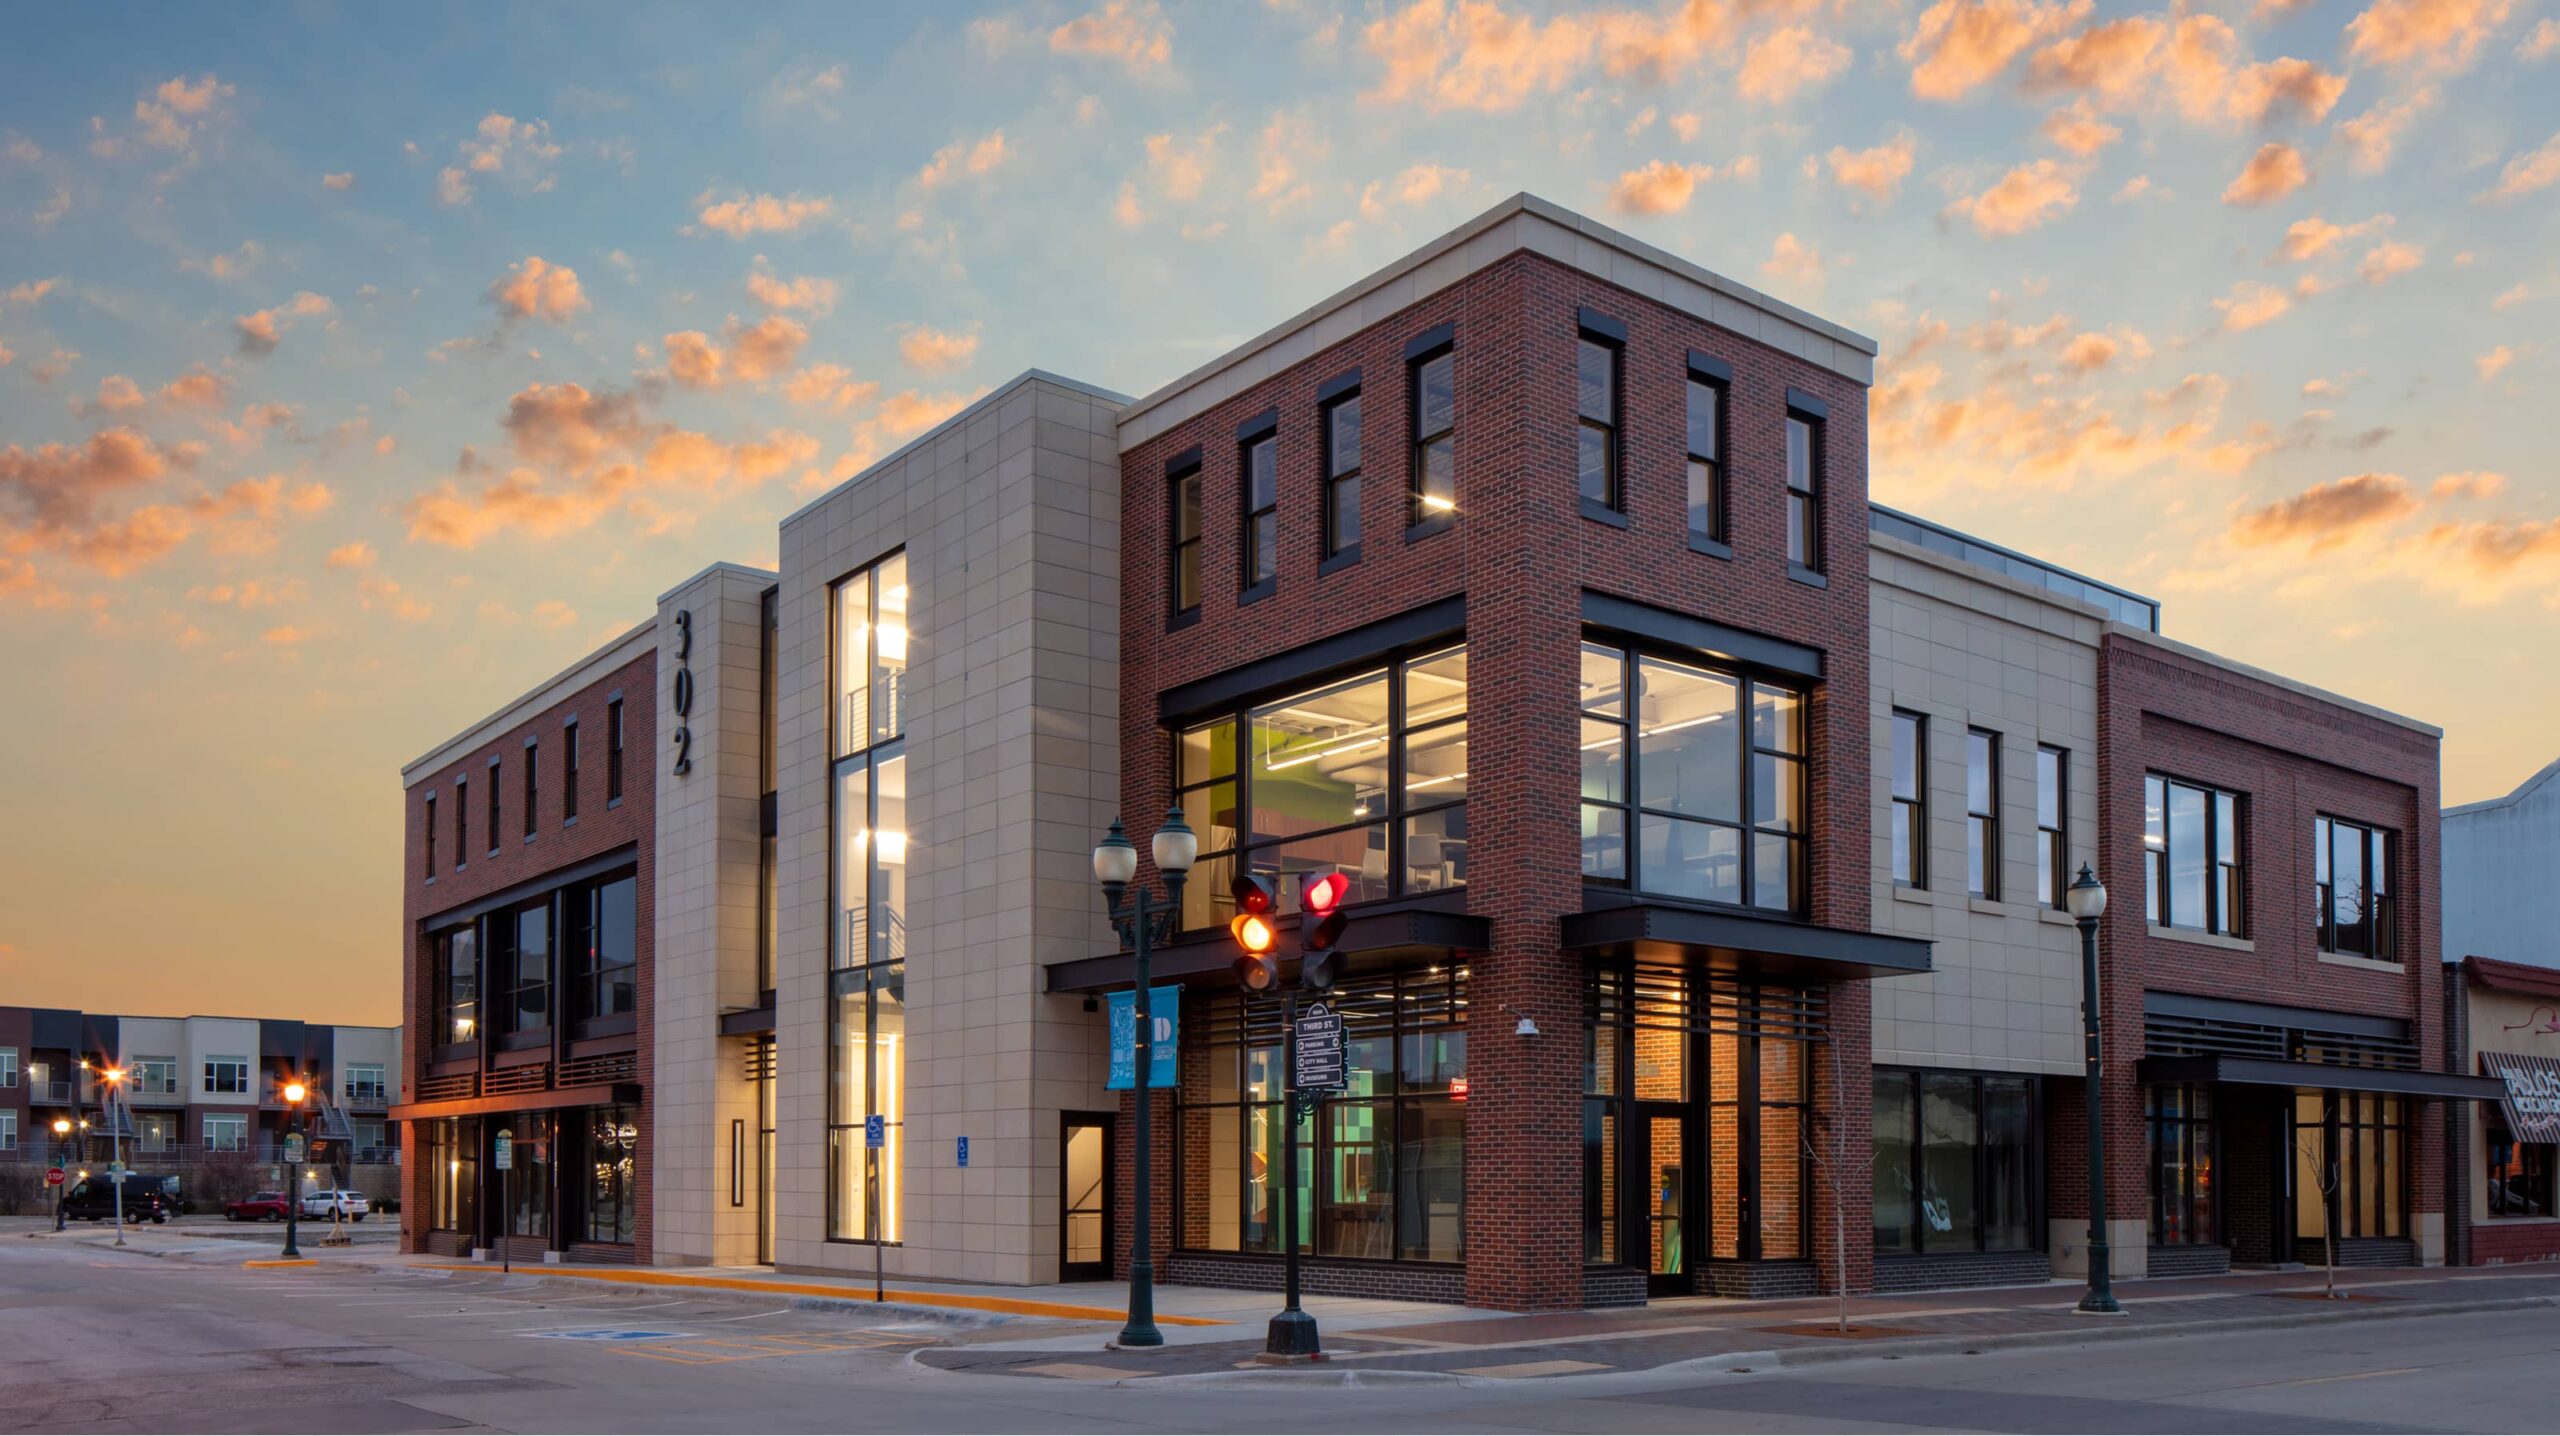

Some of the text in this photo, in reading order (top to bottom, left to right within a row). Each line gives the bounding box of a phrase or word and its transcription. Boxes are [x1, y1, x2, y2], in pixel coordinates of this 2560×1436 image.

[673, 609, 693, 777] 302
[1303, 1020, 1334, 1031] THIRD ST.
[47, 1172, 65, 1181] STOP
